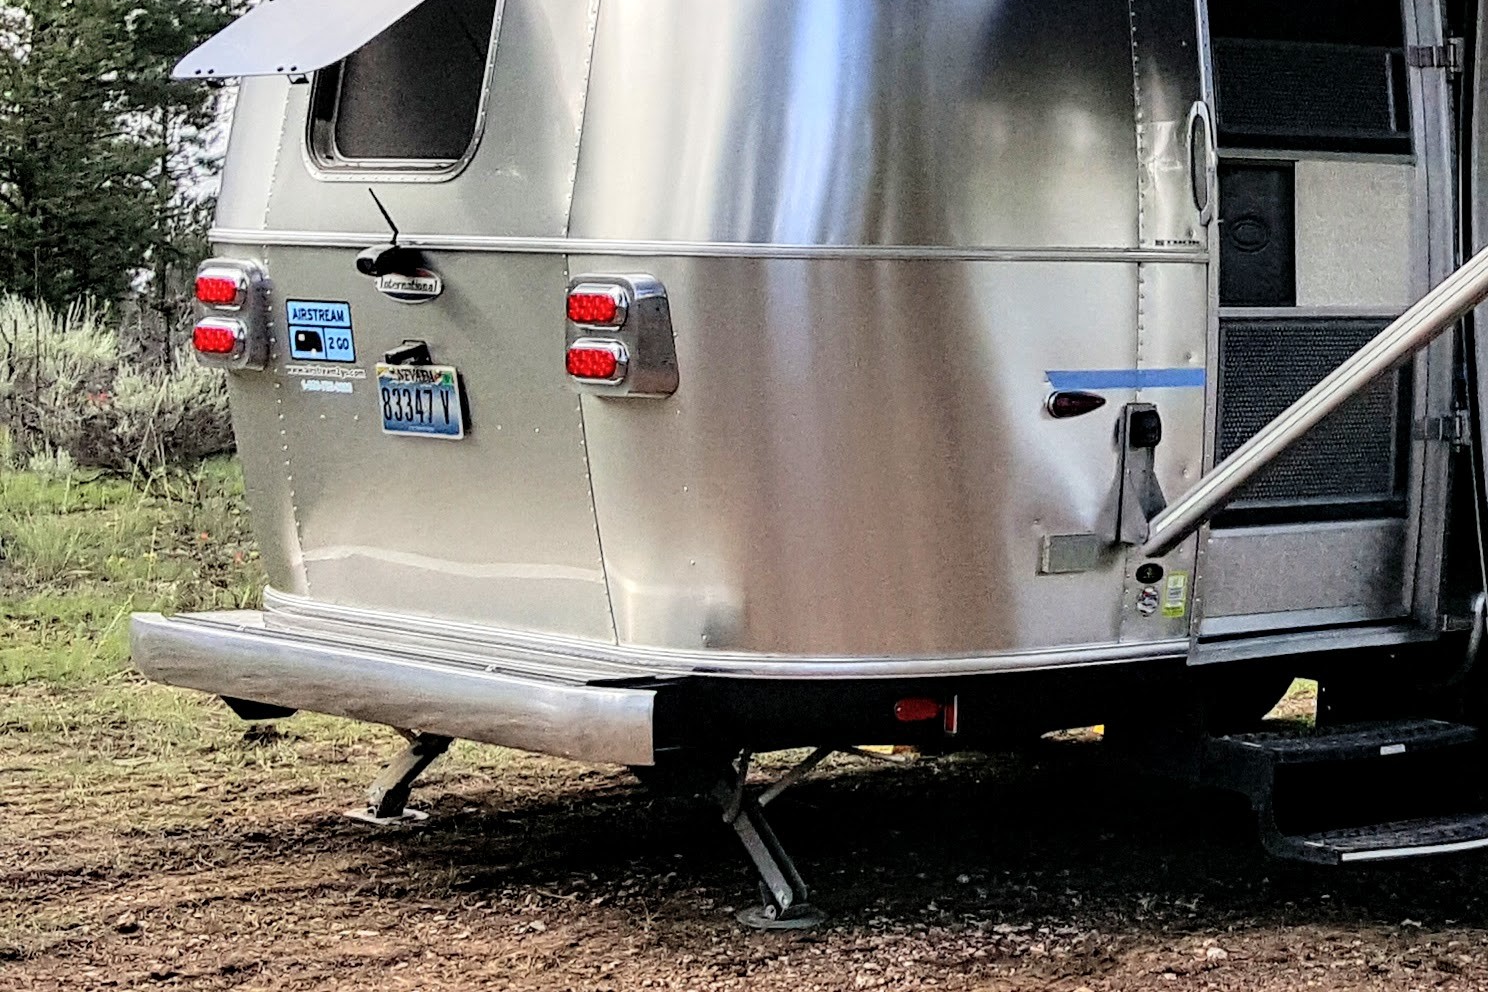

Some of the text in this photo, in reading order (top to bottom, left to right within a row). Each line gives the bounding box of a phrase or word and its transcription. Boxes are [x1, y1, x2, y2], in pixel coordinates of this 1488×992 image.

[380, 276, 438, 293] International
[292, 308, 345, 322] AIRSTREAM
[328, 336, 349, 351] 2 GO
[396, 368, 435, 383] NEVADA
[381, 387, 450, 425] 83347 V
